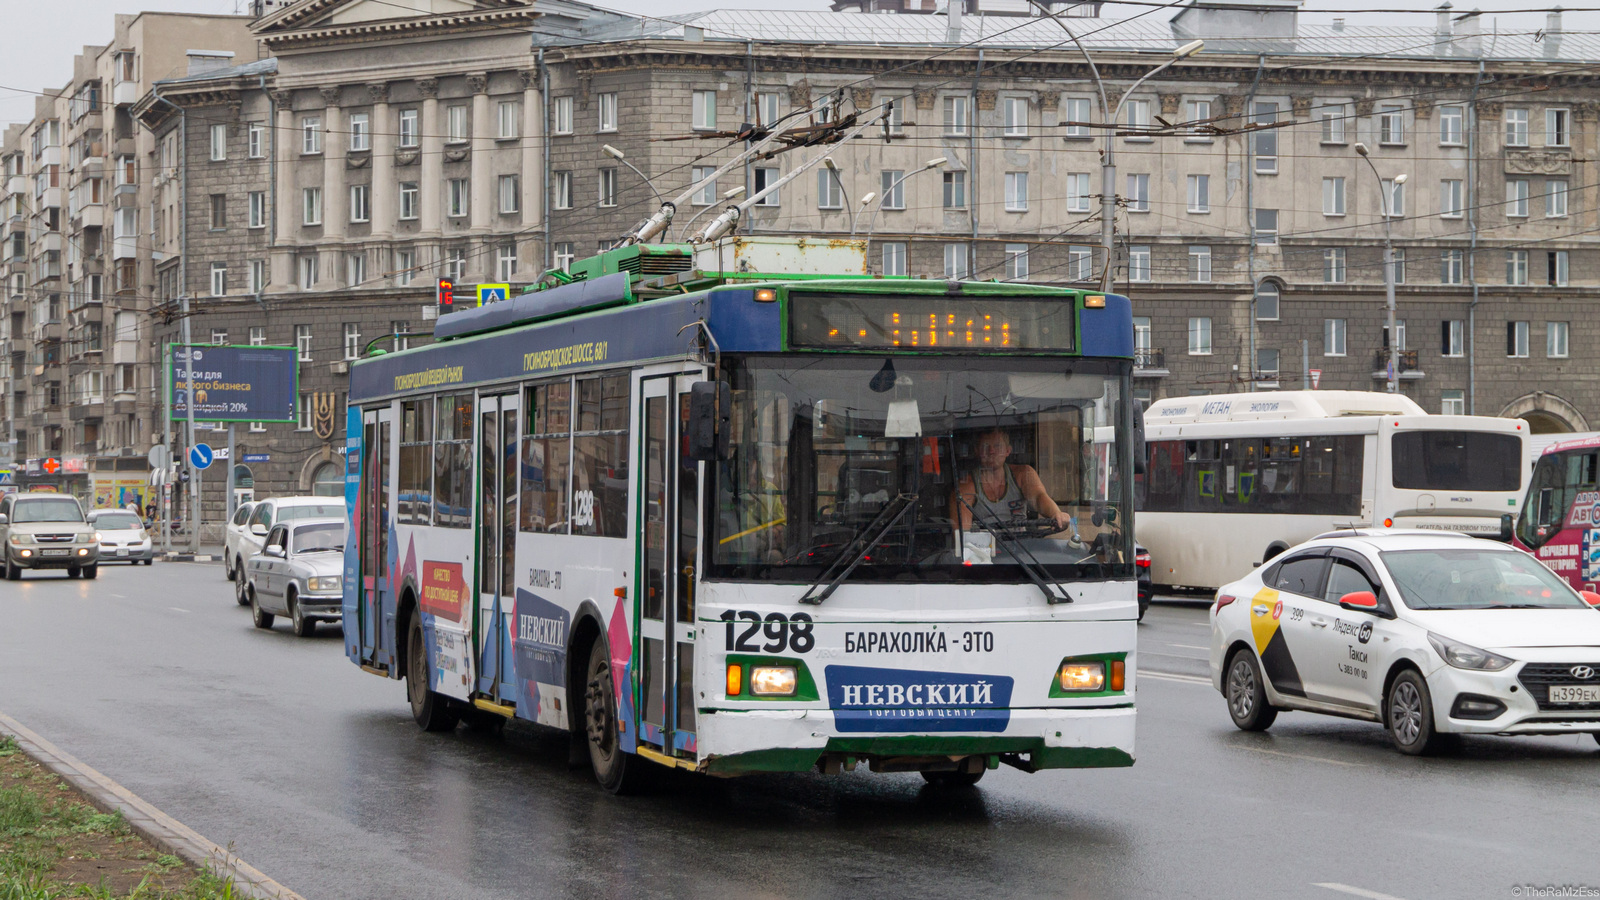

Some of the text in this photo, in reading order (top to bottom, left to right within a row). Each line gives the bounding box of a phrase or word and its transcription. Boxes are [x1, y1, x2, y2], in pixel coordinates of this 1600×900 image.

[439, 291, 453, 304] 16
[523, 341, 608, 371] ГУСИНОБРОДСКОЕ ШОССЕ, 68/1
[175, 368, 222, 380] Таси для
[394, 364, 464, 391] ГУСИНОБРОДСКИЙ ВЕЩЕВОЙ РЫНОК
[212, 381, 251, 391] бизнеса
[193, 402, 228, 413] кидкой
[229, 402, 248, 412] 20%
[1160, 407, 1187, 416] ЭКОНОМИЯ
[1202, 401, 1232, 415] МЕТАН
[1250, 402, 1279, 412] ЭКОЛОГИЯ
[1577, 493, 1598, 503] АВТО
[574, 489, 594, 526] 1298
[1583, 533, 1589, 542] A
[1540, 544, 1579, 557] ОБУЧАЕМ НА
[1583, 550, 1588, 560] B
[1290, 607, 1304, 622] 399
[519, 614, 564, 648] НЕВСКИЙ
[720, 609, 815, 654] 1298
[1332, 618, 1371, 640] Яндекс Go
[845, 631, 947, 654] БАРАХОЛКА
[963, 632, 994, 653] ЭТО
[1348, 645, 1368, 663] Такси
[841, 681, 994, 706] НЕВСКИЙ
